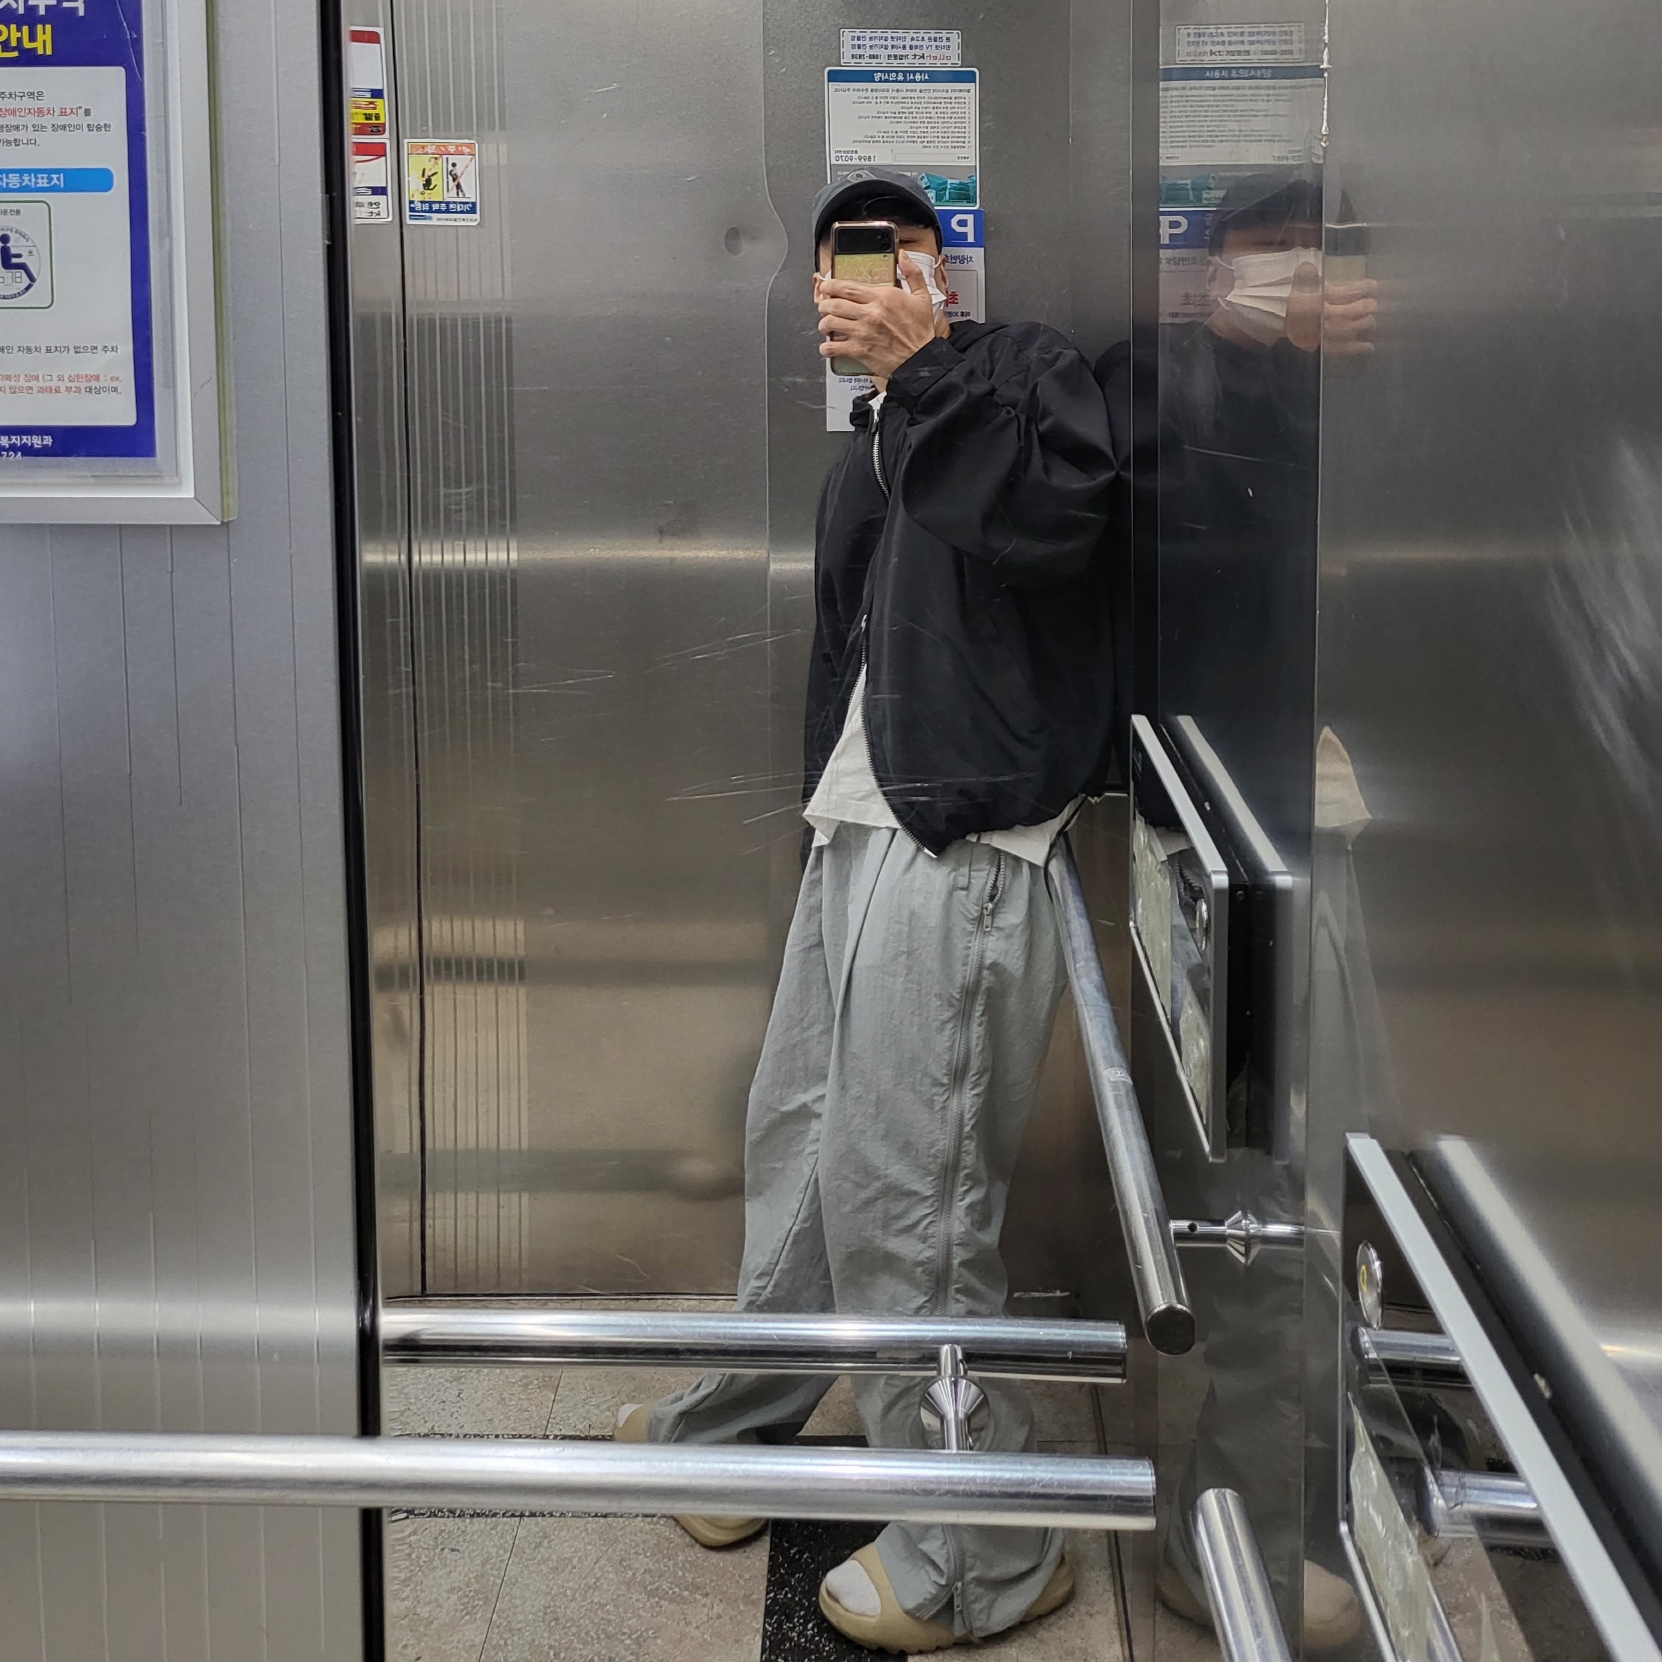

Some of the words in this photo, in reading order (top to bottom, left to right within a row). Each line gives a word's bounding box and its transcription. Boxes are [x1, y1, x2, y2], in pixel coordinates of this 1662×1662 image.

[0, 24, 52, 58] 안내
[31, 124, 48, 132] 있는
[50, 123, 84, 132] 장애인이
[86, 122, 112, 132] 탑승한
[16, 345, 42, 354] 자동차
[45, 345, 70, 354] 표지가
[73, 345, 99, 354] 없으면
[101, 345, 119, 354] 주차
